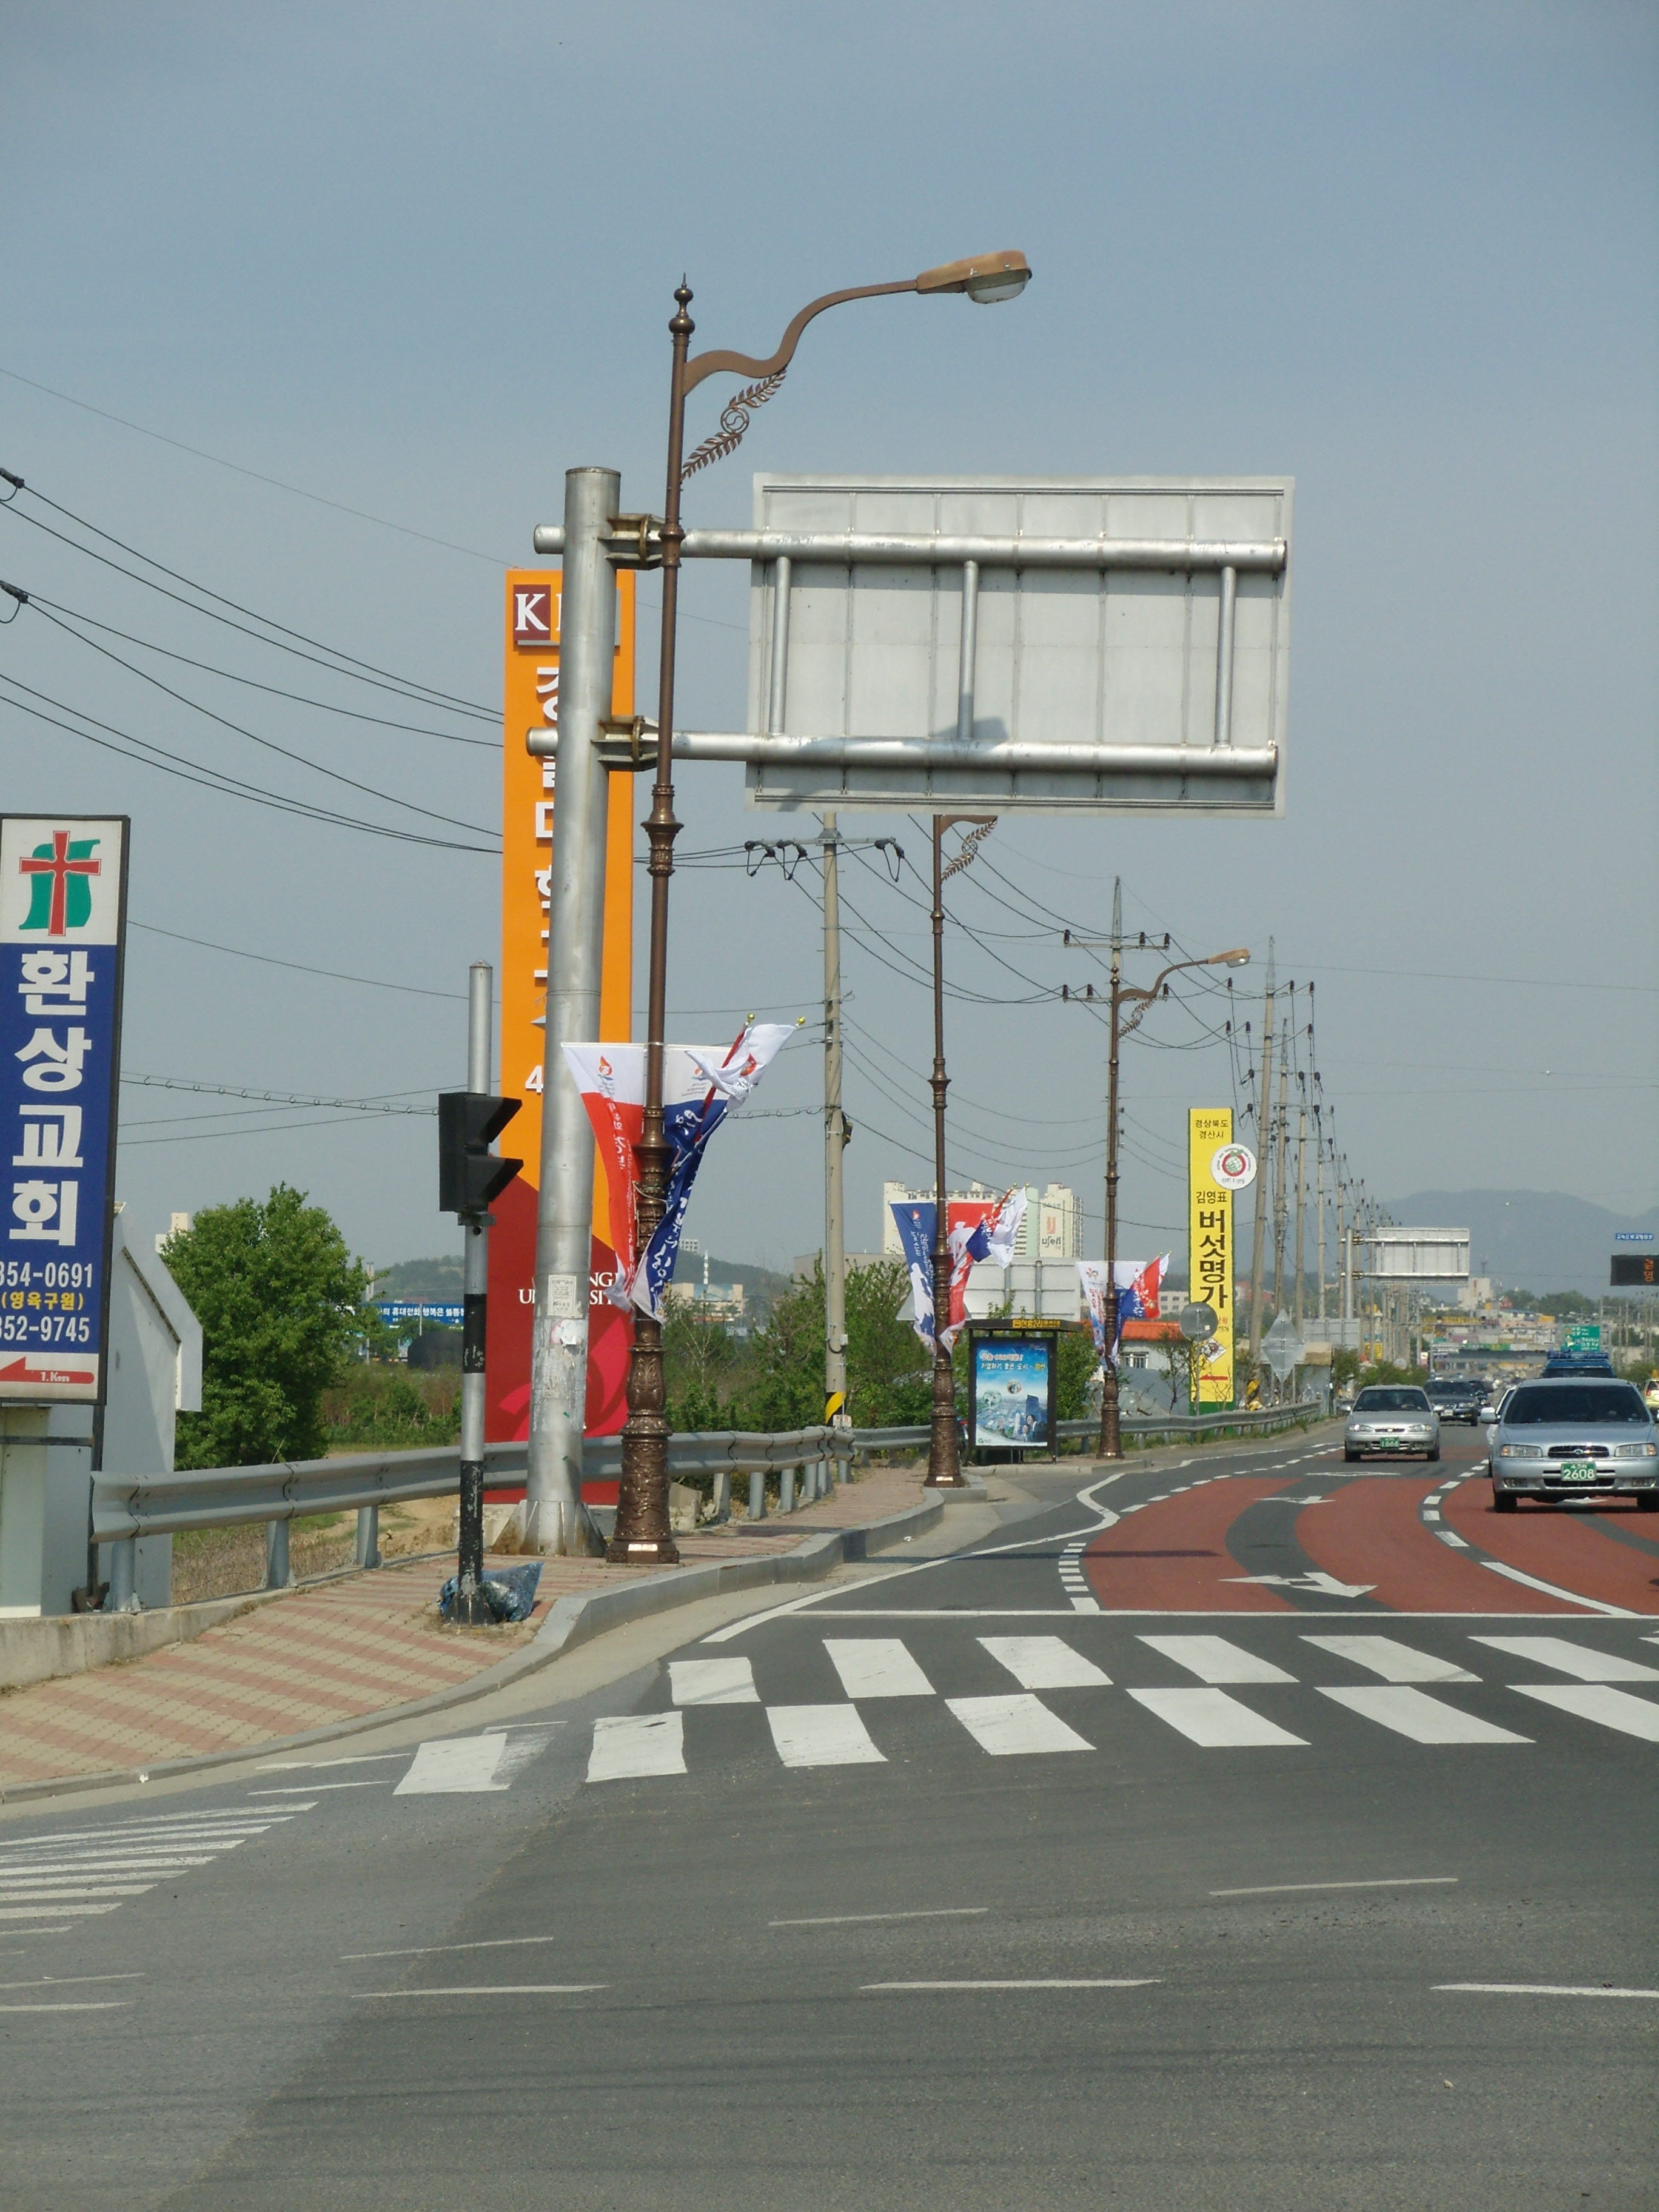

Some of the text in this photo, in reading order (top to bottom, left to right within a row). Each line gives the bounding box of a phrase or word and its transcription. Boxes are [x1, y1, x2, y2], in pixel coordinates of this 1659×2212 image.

[9, 950, 95, 1246] 환상교회
[1195, 1119, 1228, 1128] 경상북도
[1199, 1131, 1224, 1139] 경산시
[1196, 1191, 1227, 1204] 김영표
[1199, 1210, 1228, 1309] 버섯명가
[2, 1292, 84, 1311] (영육구원)
[0, 1315, 90, 1342] 52-9745
[1563, 1469, 1595, 1480] 2608
